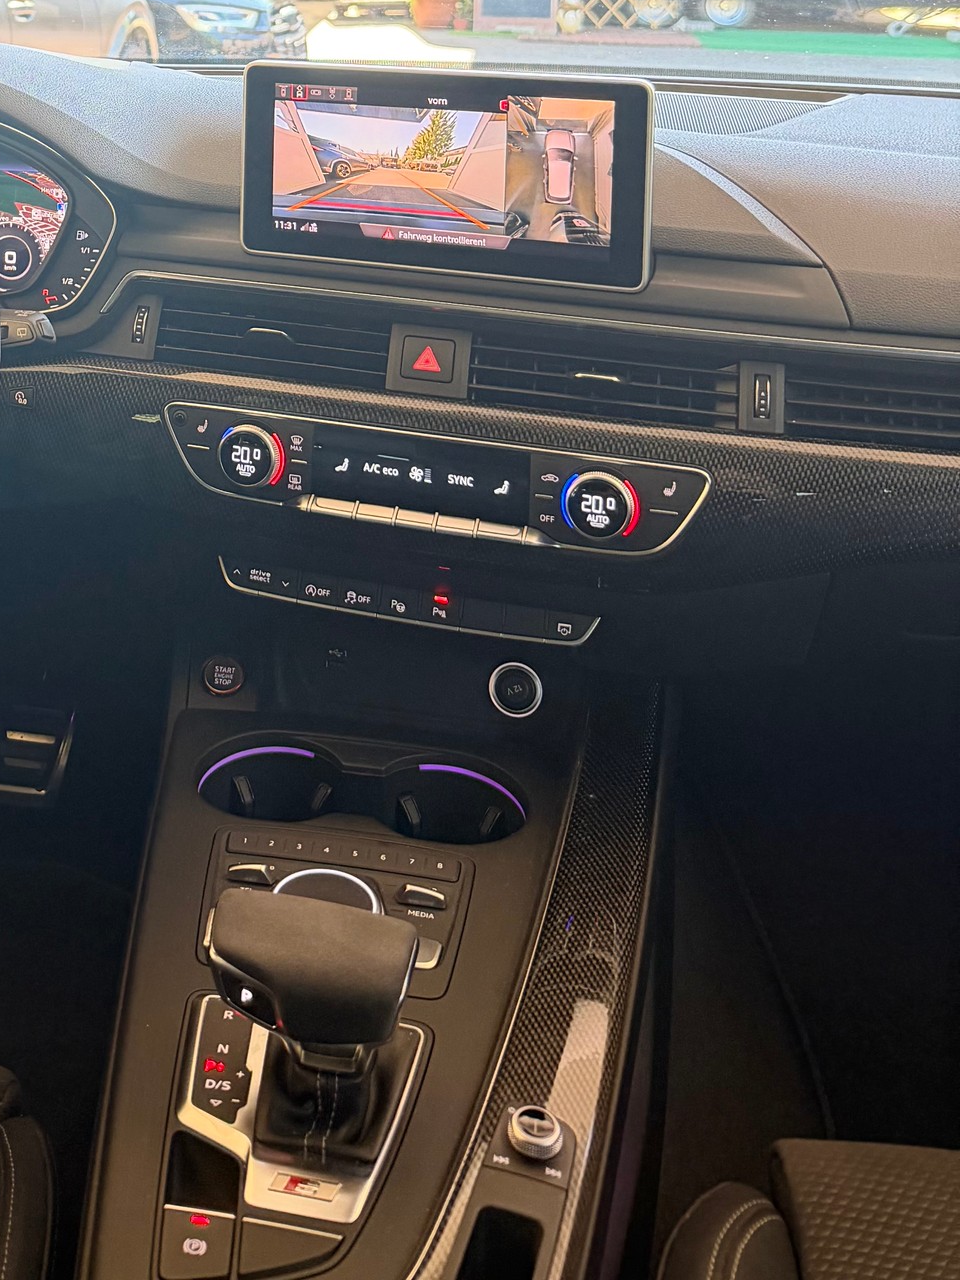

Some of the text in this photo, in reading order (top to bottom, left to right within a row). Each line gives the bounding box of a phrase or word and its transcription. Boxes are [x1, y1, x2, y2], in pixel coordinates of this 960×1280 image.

[428, 97, 448, 106] vorn
[274, 220, 297, 231] 11:31
[398, 231, 486, 246] Fahrweg kontrollieren!
[4, 251, 16, 264] 0
[236, 464, 256, 473] AUTO
[363, 462, 399, 477] A/C eco
[447, 474, 475, 487] SYNC
[540, 514, 555, 523] OFF
[586, 513, 610, 524] AUTO
[250, 568, 271, 578] drive
[249, 574, 271, 583] select
[317, 588, 331, 597] OFF
[357, 595, 371, 604] OFF
[214, 665, 236, 674] START
[214, 678, 232, 686] STOP
[407, 909, 435, 920] MEDIA
[241, 988, 253, 1002] P
[223, 1010, 234, 1019] R
[217, 1043, 229, 1054] N
[205, 1079, 231, 1091] D/S
